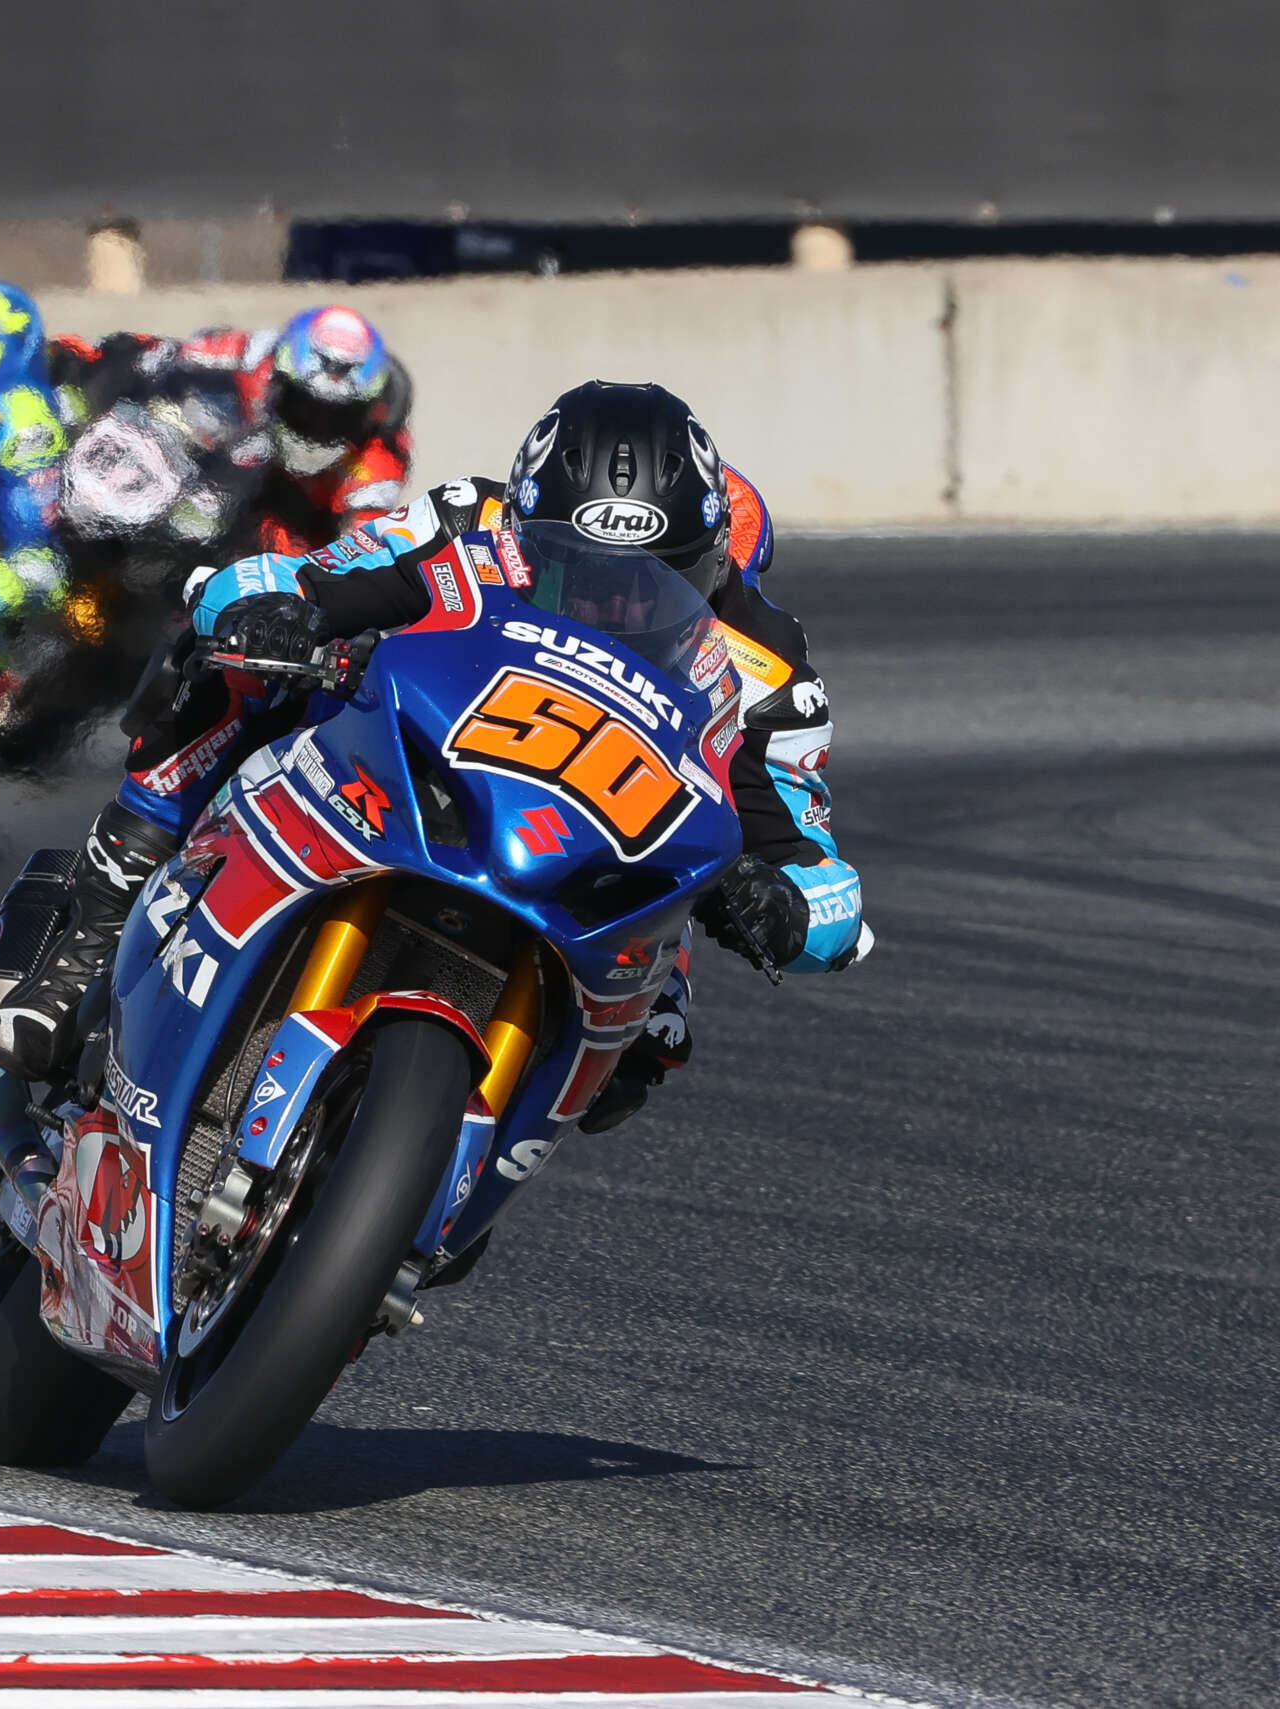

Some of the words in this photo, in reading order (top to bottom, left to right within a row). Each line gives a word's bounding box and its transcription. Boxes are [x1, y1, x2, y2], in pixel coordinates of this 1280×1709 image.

[582, 505, 655, 532] Arai
[432, 562, 464, 612] ECSTAR
[501, 621, 683, 732] SUZUKI
[726, 645, 768, 669] UNLOP
[564, 664, 644, 715] MOTOAMERICA
[451, 671, 690, 843] 50
[327, 794, 381, 842] GSX
